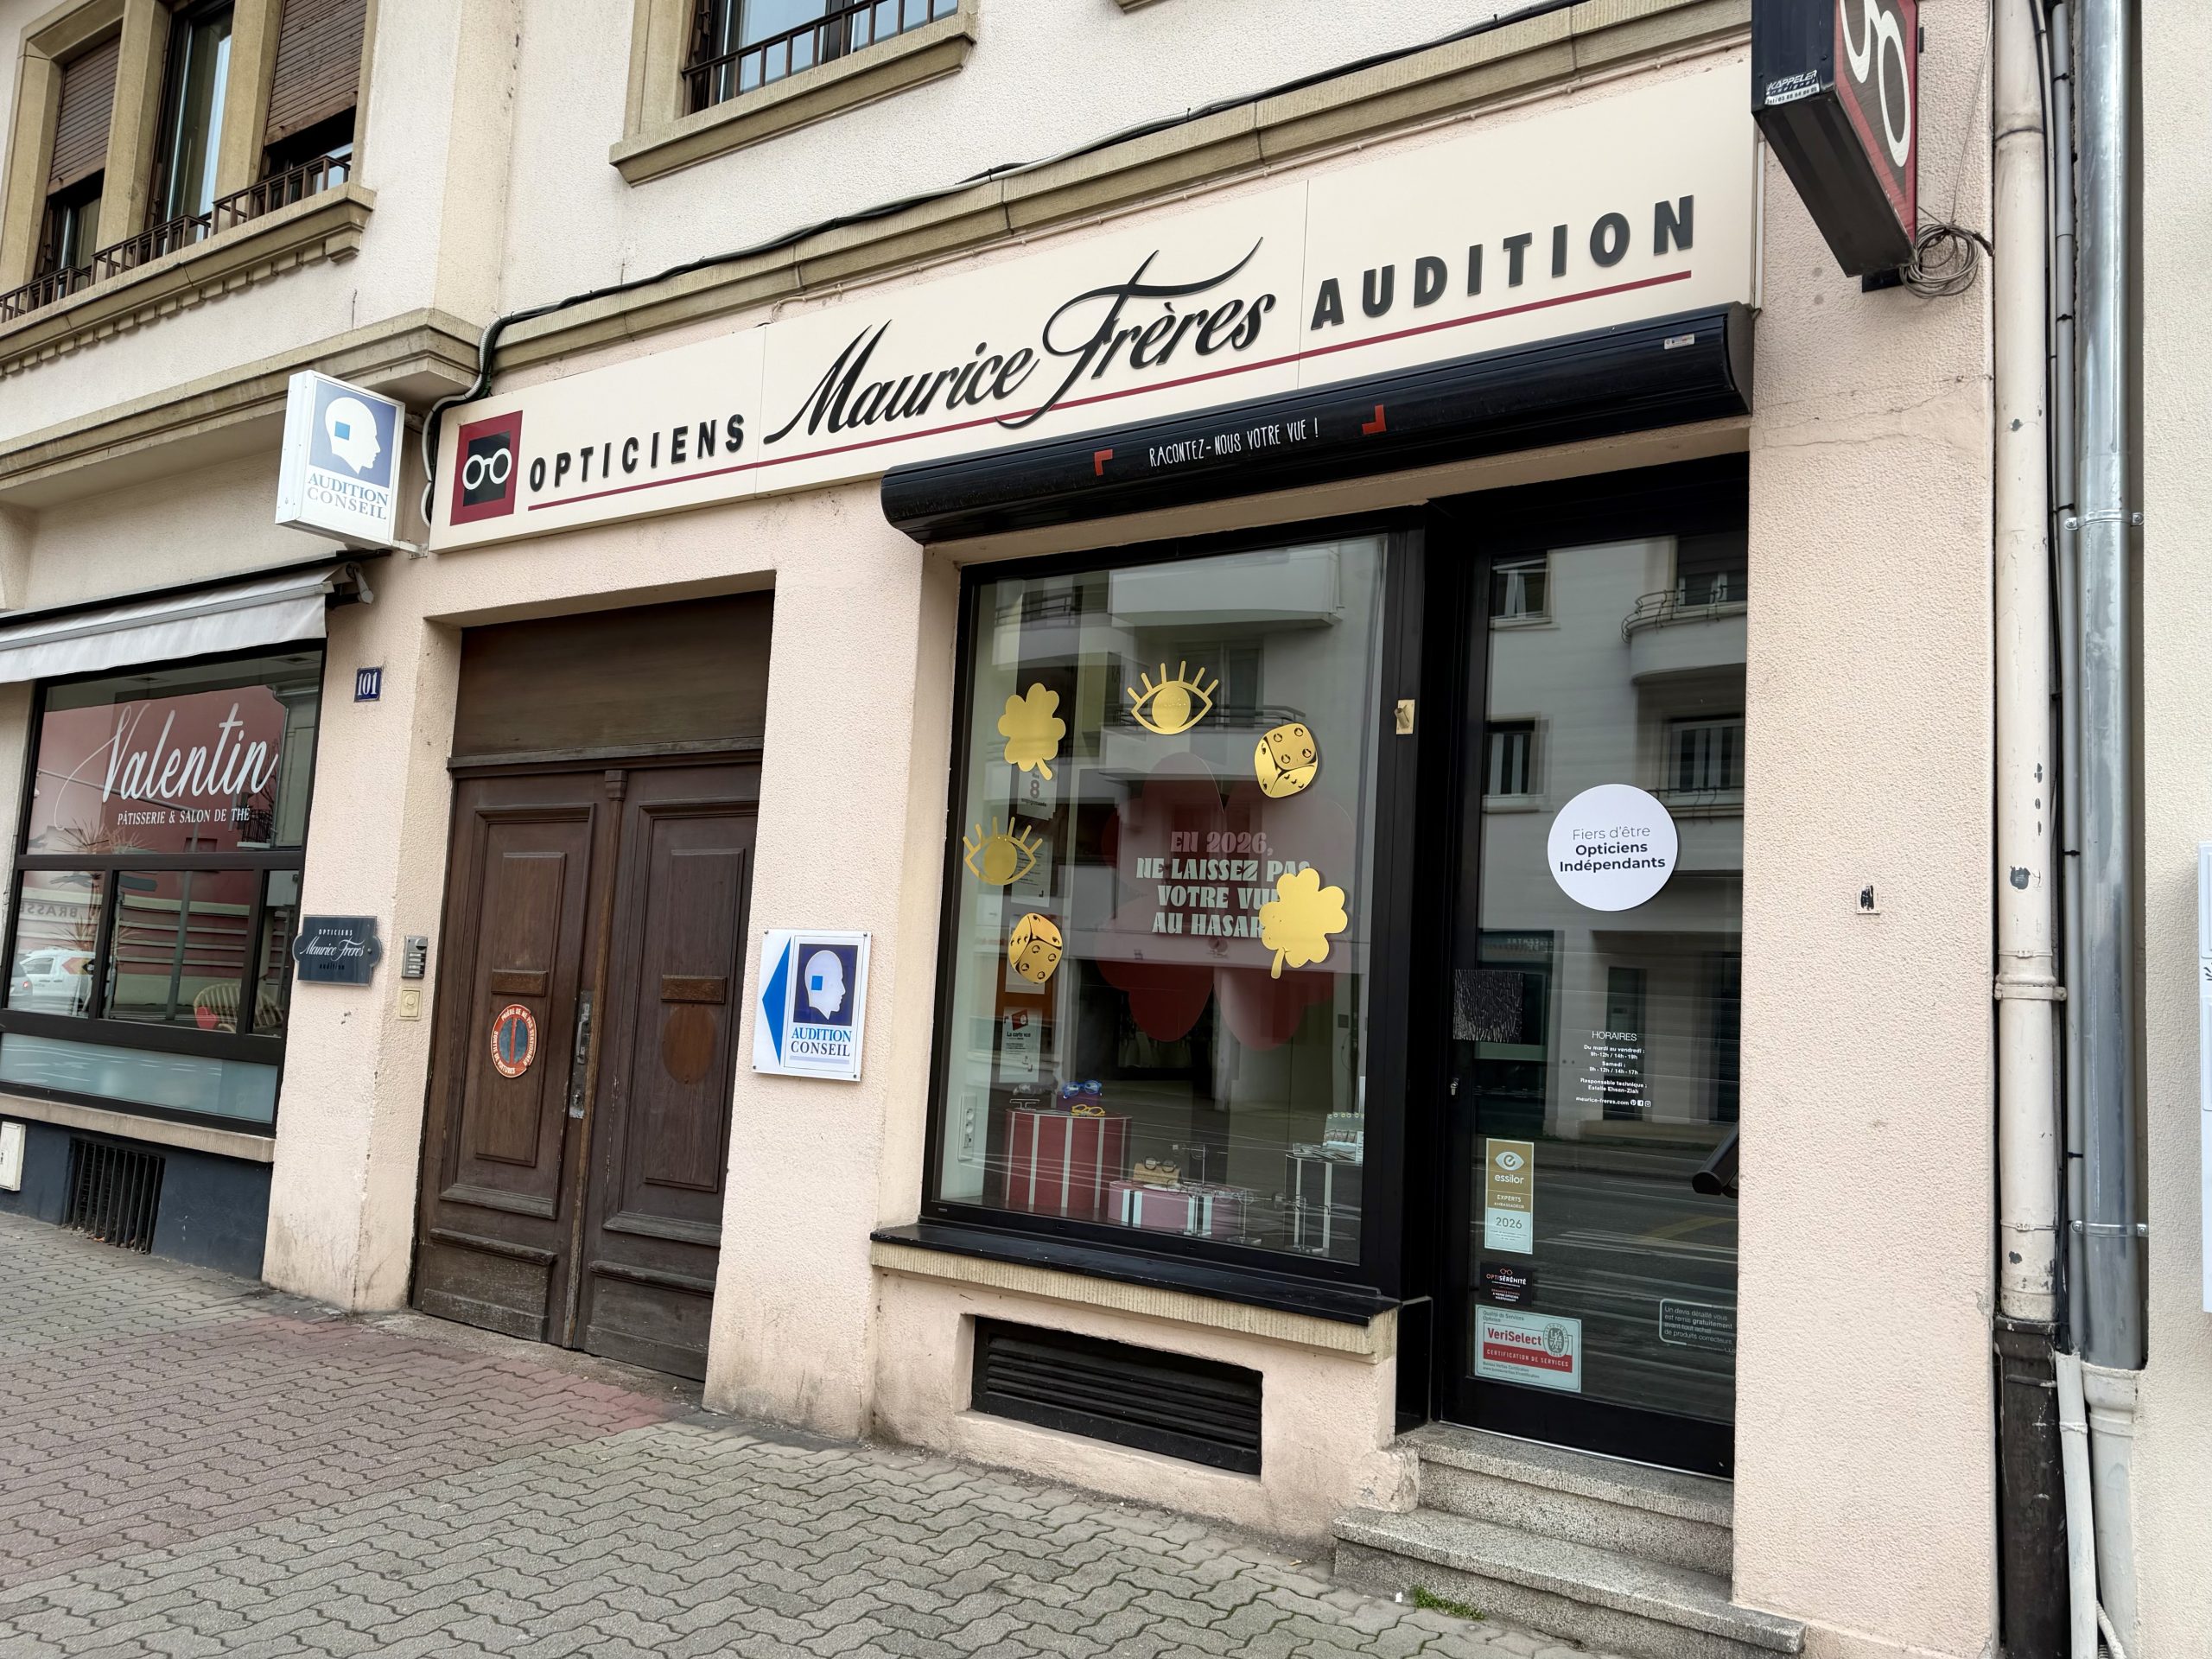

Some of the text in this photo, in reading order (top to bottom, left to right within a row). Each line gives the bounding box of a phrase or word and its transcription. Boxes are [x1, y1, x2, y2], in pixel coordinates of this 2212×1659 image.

[1767, 69, 1817, 91] KAPPELER
[530, 194, 1694, 493] OPTICIENS Maurice Frères AUDITION
[1247, 423, 1281, 450] VOTRE
[1286, 418, 1307, 442] VUE
[1314, 417, 1319, 438] !
[308, 473, 389, 506] AUDITION
[307, 486, 387, 520] CONSEIL
[357, 671, 378, 696] 101
[54, 702, 279, 830] Valentin
[1030, 779, 1039, 798] 8
[118, 804, 251, 825] PÂTISSERIE & SALON DE THÉ
[1573, 825, 1650, 841] Fiers d'être
[1170, 831, 1274, 856] EN 2026,
[1575, 842, 1648, 857] Opticiens
[1136, 858, 1165, 879] NE
[1171, 858, 1259, 881] LAISSEZ
[1560, 856, 1666, 873] Indépendants
[1158, 886, 1230, 908] VOTRE
[1152, 912, 1184, 934] AU
[299, 936, 337, 956] Maurice
[522, 1011, 528, 1020] NE
[791, 1027, 852, 1042] AUDITION
[1592, 1031, 1637, 1041] HORAIRES
[523, 1029, 534, 1066] STATIONNER
[791, 1040, 850, 1057] CONSEIL
[494, 1052, 500, 1061] DE
[498, 1060, 516, 1074] VOITURES
[1494, 1174, 1524, 1185] essilor
[1497, 1194, 1522, 1203] EXPERTS
[1496, 1217, 1522, 1229] 2026
[1505, 1313, 1524, 1321] Services
[1692, 1318, 1732, 1329] gratuitement
[1487, 1327, 1541, 1345] VeriSelect
[1673, 1330, 1698, 1340] produits
[1486, 1349, 1529, 1361] CERTIFICATION
[1541, 1357, 1569, 1367] SERVICES
